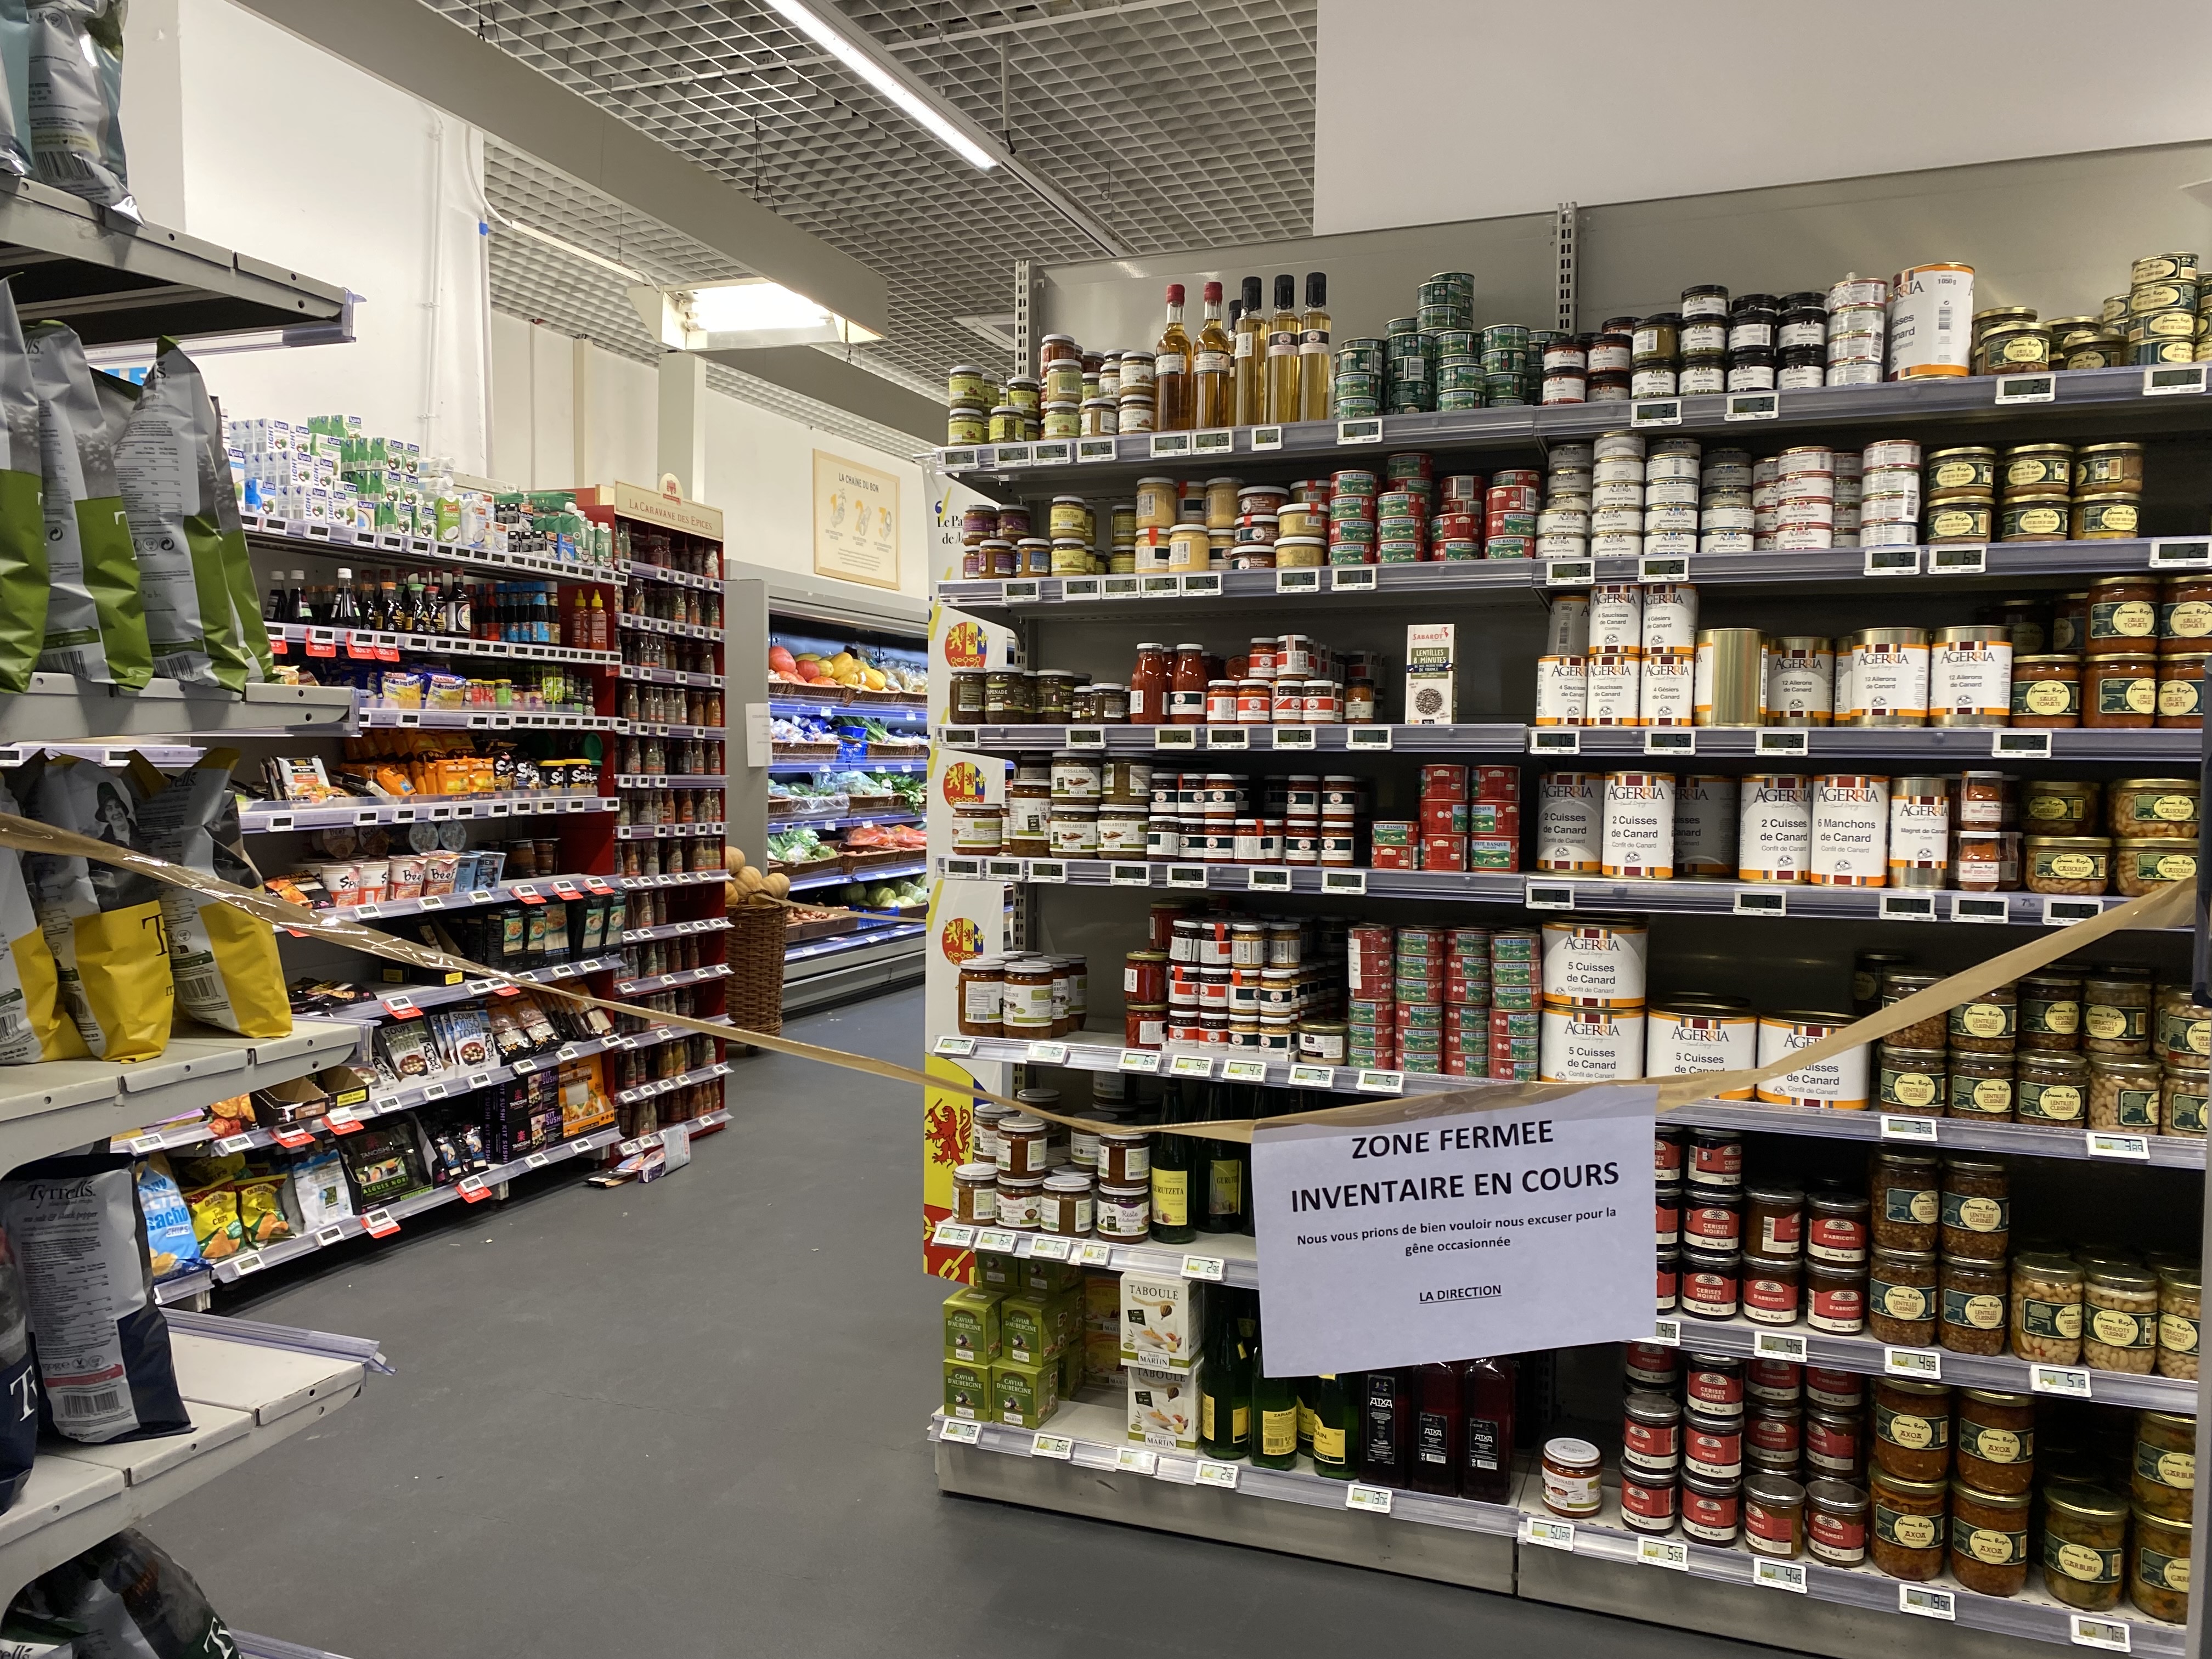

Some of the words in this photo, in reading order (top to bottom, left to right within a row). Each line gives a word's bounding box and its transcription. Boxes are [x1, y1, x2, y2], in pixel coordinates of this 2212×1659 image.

[839, 472, 844, 482] LA
[863, 480, 868, 489] DU
[870, 483, 879, 493] BON
[640, 503, 675, 520] CARAVANE
[678, 511, 689, 523] DES
[691, 514, 713, 531] EPICES
[937, 516, 950, 527] Le
[943, 533, 953, 544] de
[1593, 592, 1636, 606] AGERRIA
[1940, 650, 1995, 663] AGERRIA
[1645, 664, 1689, 676] AGERRIA
[1608, 785, 1664, 800] AGERRIA
[1817, 786, 1878, 803] AGERRIA
[1619, 816, 1657, 825] Cuisses
[1818, 819, 1822, 827] 6
[1824, 819, 1876, 829] Manchons
[1612, 829, 1621, 837] de
[1623, 830, 1658, 838] Canard
[1833, 833, 1871, 842] Canard
[431, 867, 456, 879] Beef
[1564, 935, 1620, 951] AGERRIA
[1576, 962, 1615, 972] Cuisses
[1567, 974, 1578, 983] de
[1581, 975, 1615, 984] Canard
[385, 1025, 410, 1036] SOUPE
[455, 1020, 479, 1030] MISO
[1565, 1020, 1620, 1036] AGERRIA
[456, 1029, 481, 1038] TOFU
[1672, 1025, 1729, 1042] AGERRIA
[1577, 1047, 1615, 1057] Cuisses
[1684, 1053, 1724, 1063] Cuisses
[1582, 1060, 1616, 1069] Canard
[546, 1115, 562, 1125] SUSHI
[1352, 1131, 1430, 1159] ZONE
[1440, 1120, 1553, 1151] FERMEE
[363, 1183, 389, 1194] ALGUES
[1291, 1175, 1464, 1212] INVENTAIRE
[1475, 1172, 1511, 1195] EN
[1521, 1162, 1620, 1193] COURS
[1297, 1233, 1327, 1245] Nous
[1330, 1232, 1358, 1243] vous
[1362, 1226, 1398, 1240] prions
[1402, 1224, 1417, 1236] de
[1420, 1220, 1447, 1234] bien
[1449, 1218, 1492, 1232] vouloir
[1495, 1217, 1524, 1228] nous
[1527, 1212, 1572, 1226] excuser
[1576, 1209, 1603, 1224] pour
[1606, 1207, 1616, 1218] la
[1405, 1242, 1434, 1257] gêne
[1437, 1237, 1510, 1252] occasionnée
[1419, 1290, 1434, 1302] LA
[1437, 1284, 1501, 1300] DIRECTION
[948, 1322, 981, 1331] D'AUBERGINE
[1140, 1356, 1167, 1365] MARTIN
[948, 1379, 982, 1389] D'AUBERGINE
[1900, 1431, 1922, 1439] AXOA
[1147, 1437, 1174, 1447] MARTIN
[1980, 1545, 2002, 1554] AXOA
[2064, 1559, 2097, 1572] GARBURE
